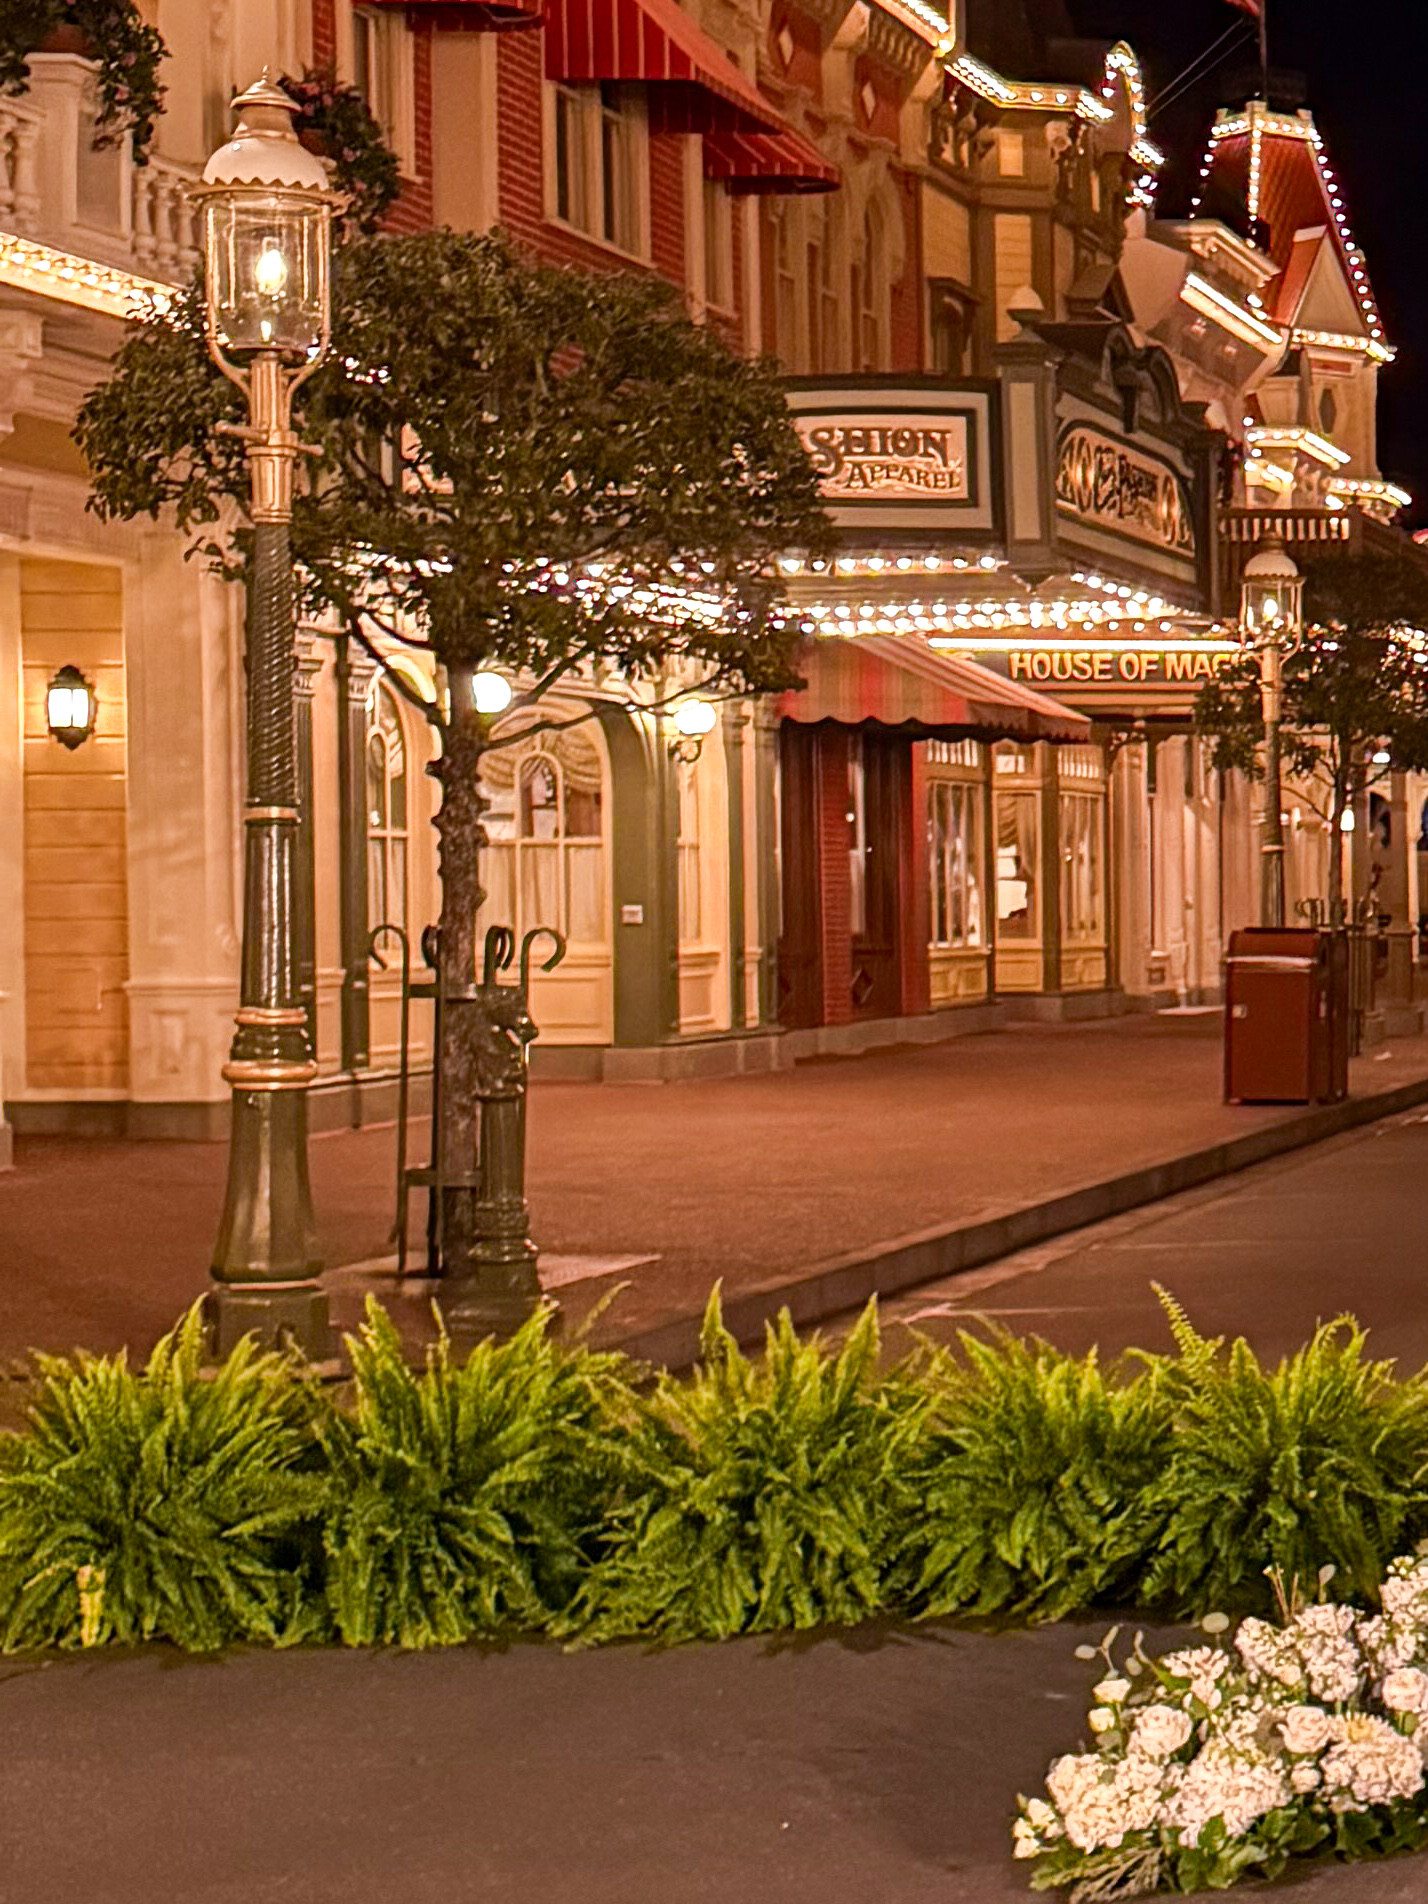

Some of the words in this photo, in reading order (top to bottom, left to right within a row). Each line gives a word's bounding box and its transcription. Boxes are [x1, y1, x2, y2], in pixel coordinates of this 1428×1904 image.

[847, 462, 962, 489] APPAREL
[1009, 652, 1114, 681] HOUSE
[1119, 652, 1160, 681] OF
